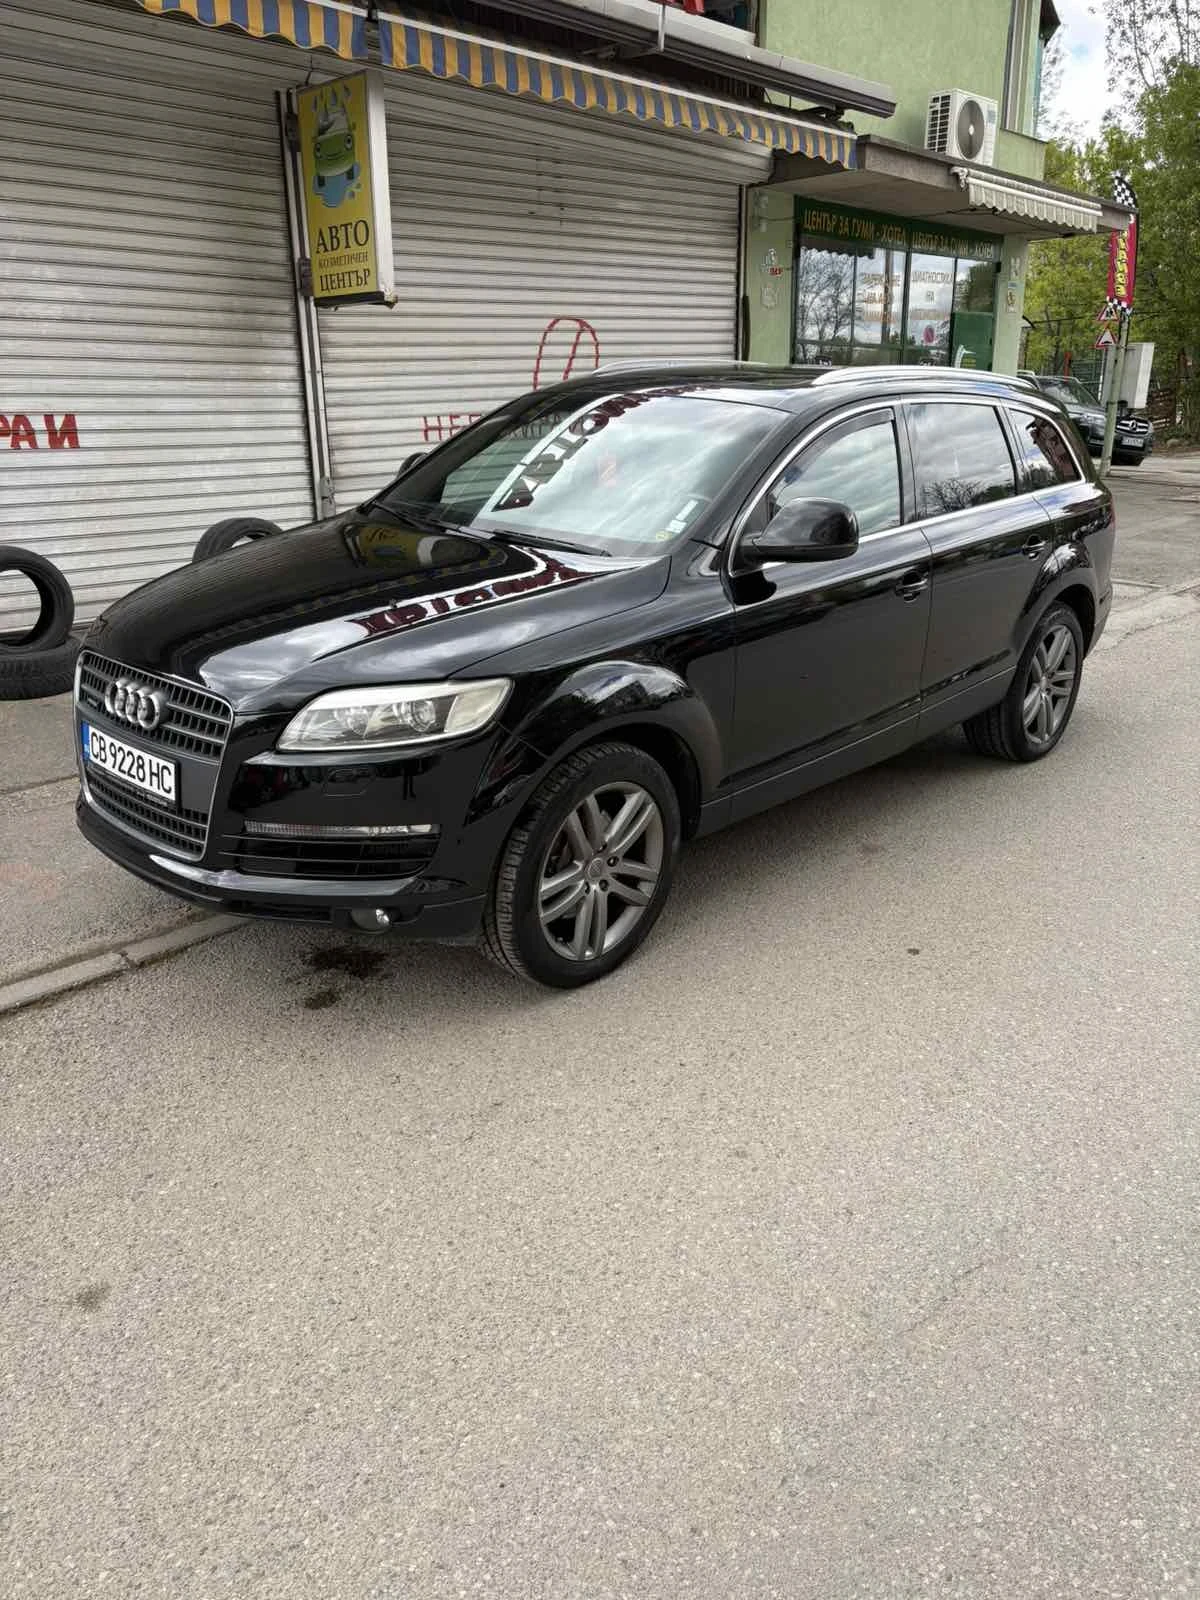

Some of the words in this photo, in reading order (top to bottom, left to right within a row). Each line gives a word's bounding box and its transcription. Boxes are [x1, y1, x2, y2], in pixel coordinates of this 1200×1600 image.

[804, 207, 837, 233] ЦЕНТЪР
[316, 219, 369, 254] АВТО
[318, 251, 369, 269] КОЗМЕТИЧЕН
[320, 268, 371, 292] ЦЕНТЪР
[90, 731, 107, 764] CB
[109, 742, 146, 783] 9228
[148, 758, 172, 794] HC
